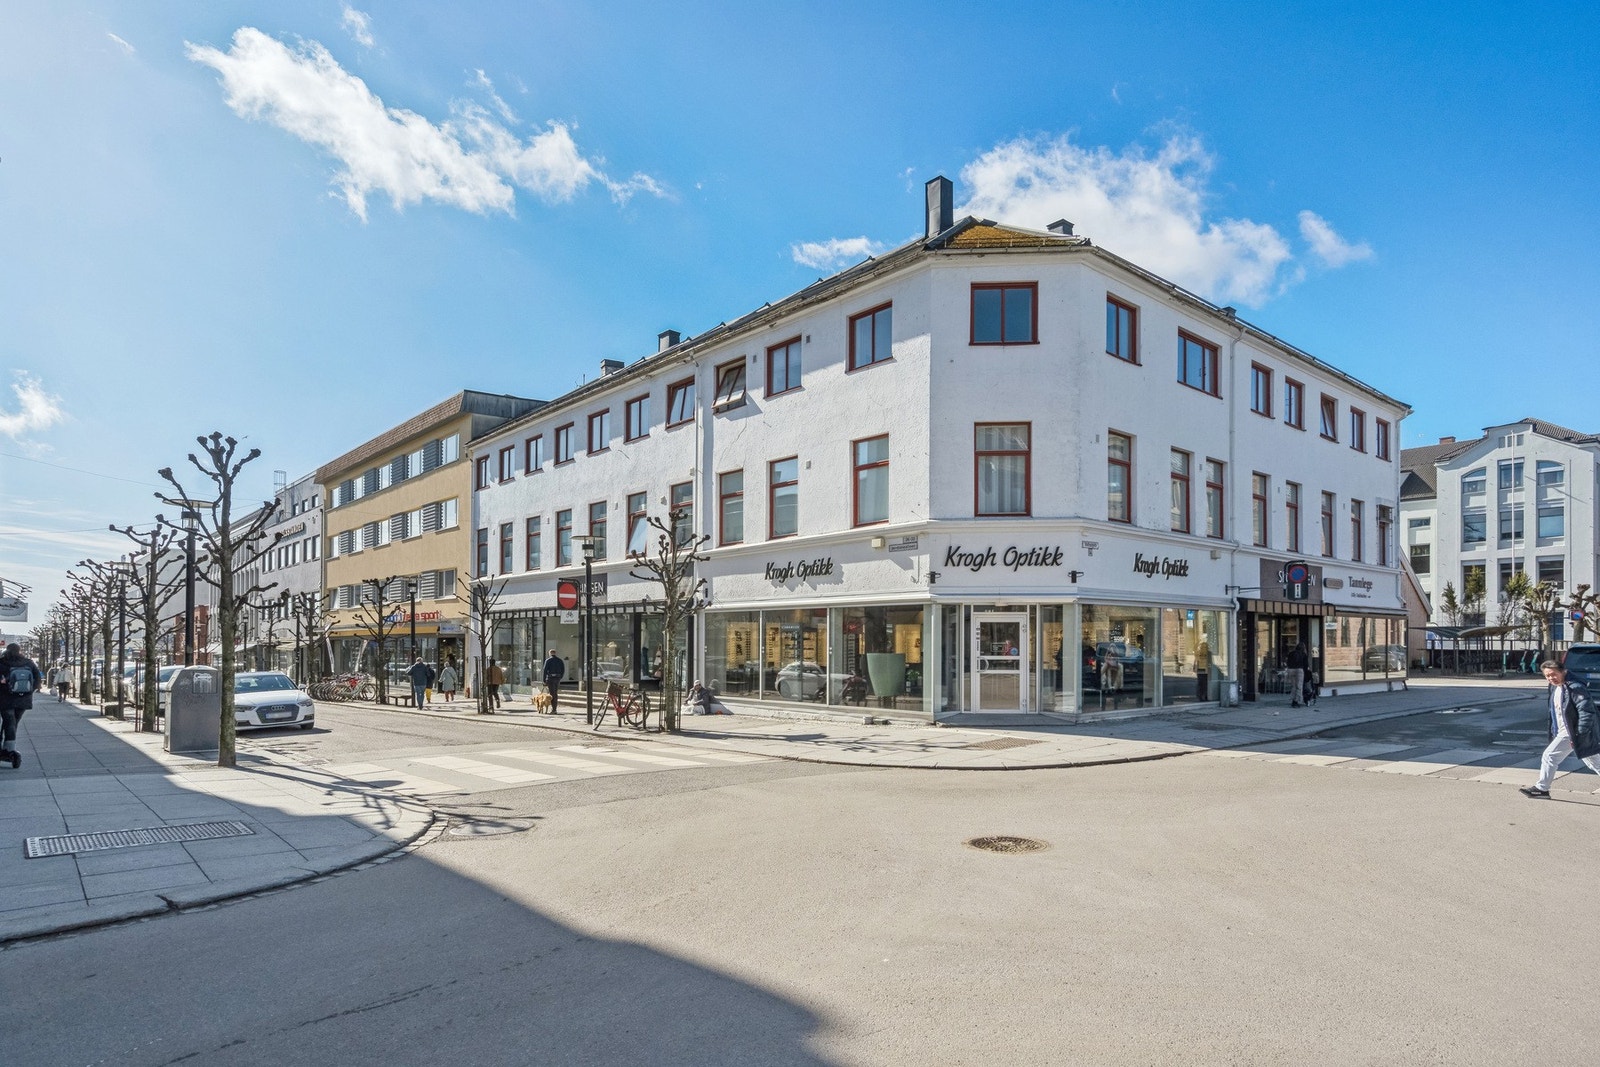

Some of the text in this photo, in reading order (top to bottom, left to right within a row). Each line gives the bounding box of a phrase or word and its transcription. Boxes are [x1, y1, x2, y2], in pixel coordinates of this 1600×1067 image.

[764, 557, 833, 583] Krogh Optikk
[944, 545, 1064, 572] Krogh Optikk
[1133, 552, 1189, 580] Krogh Optikk
